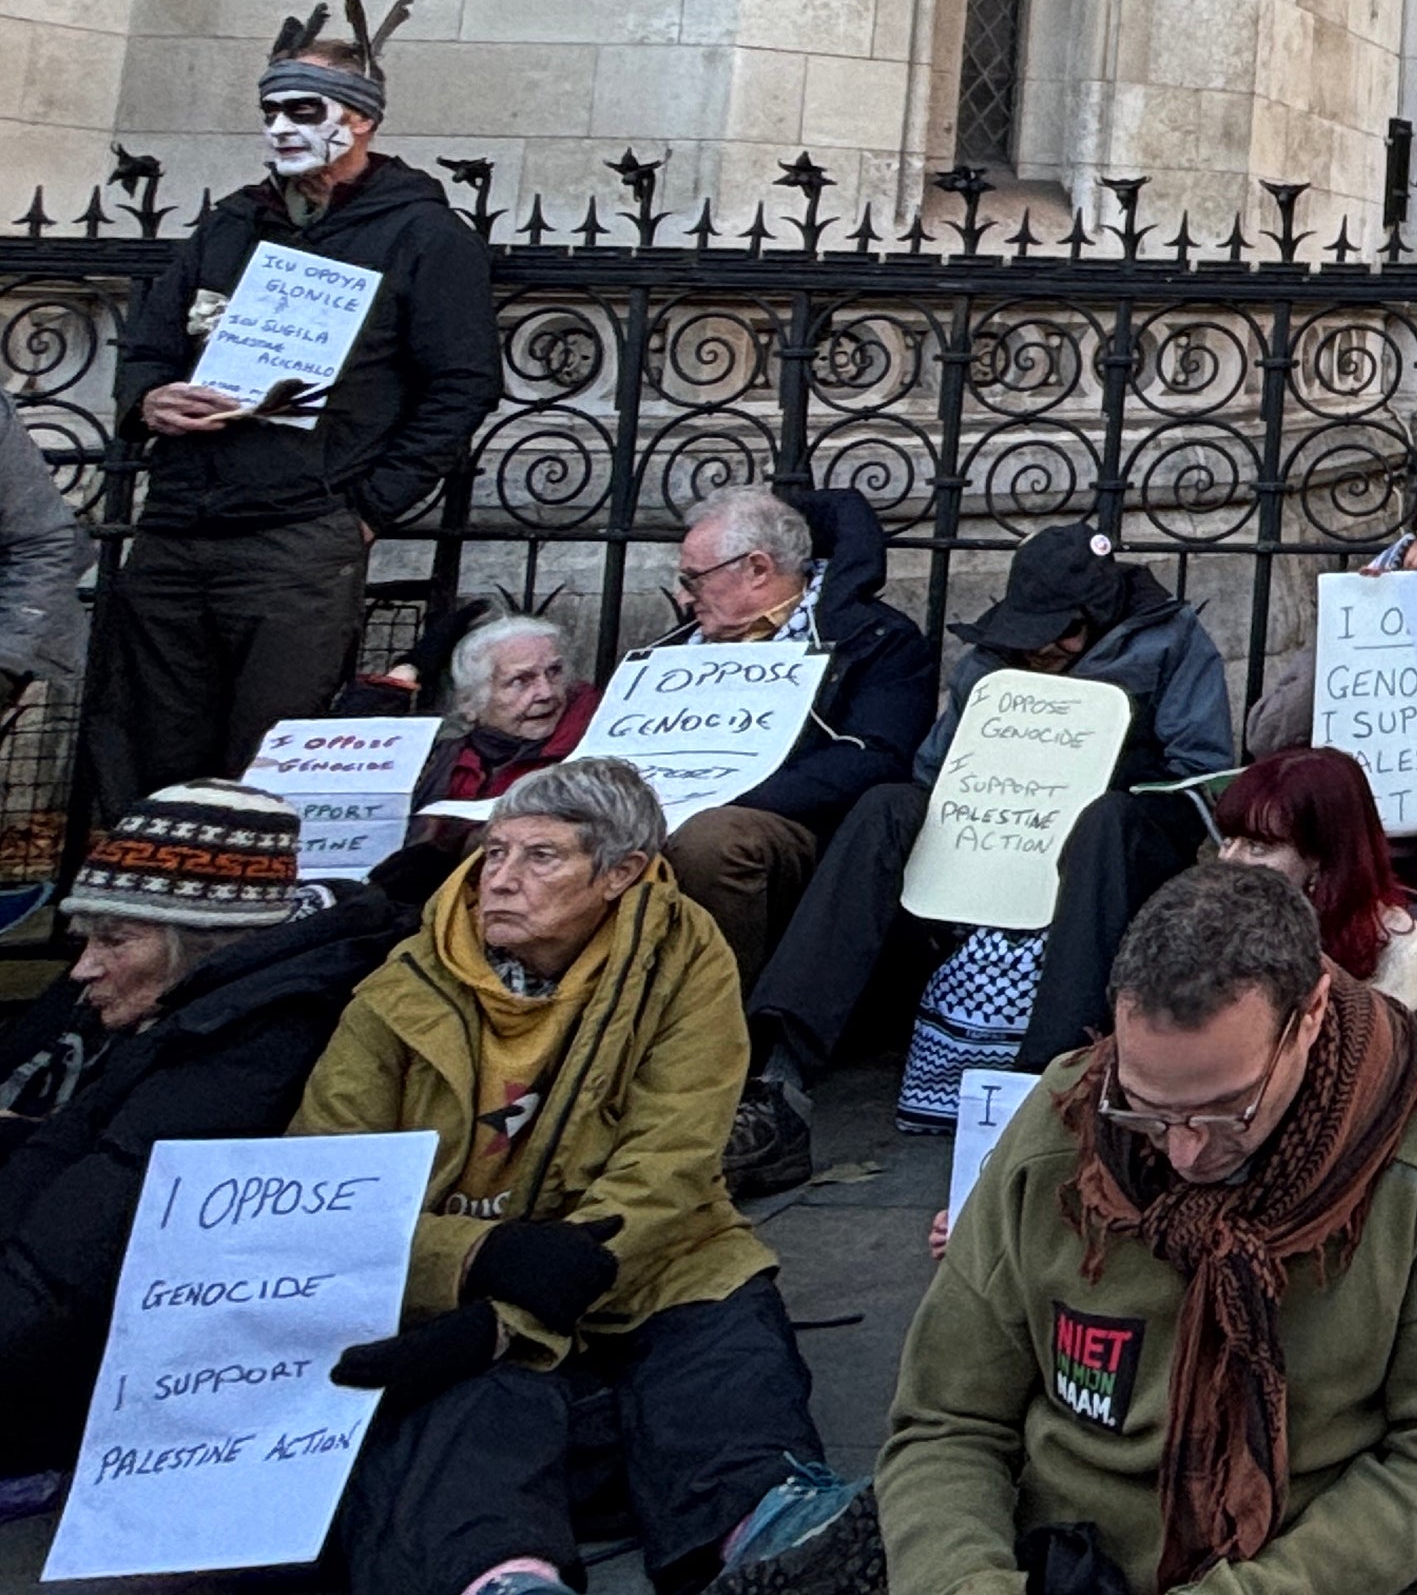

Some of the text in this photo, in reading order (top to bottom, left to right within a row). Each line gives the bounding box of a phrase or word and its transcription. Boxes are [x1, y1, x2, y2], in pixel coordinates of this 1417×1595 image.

[1337, 606, 1354, 639] I
[623, 661, 803, 701] I OPPOSE
[970, 683, 1081, 715] I OPPOSE
[608, 707, 774, 737] GENOCIDE
[981, 717, 1095, 748] GENOCIDE
[1322, 711, 1337, 743] I
[278, 758, 394, 773] GENOCIDE
[948, 752, 974, 774] I
[959, 772, 1069, 797] SUPPORT
[304, 805, 385, 820] PPORT
[941, 801, 1061, 830] PALESTINE
[955, 825, 1054, 853] ACTION
[978, 1085, 1001, 1126] I
[161, 1176, 381, 1230] I OPPOSE
[142, 1274, 337, 1311] GENOCIDE
[1057, 1312, 1133, 1374] NIET
[113, 1360, 312, 1411] I SUPPORT
[1057, 1370, 1116, 1426] NAAM.
[93, 1419, 362, 1485] PALESTINE ACTION
